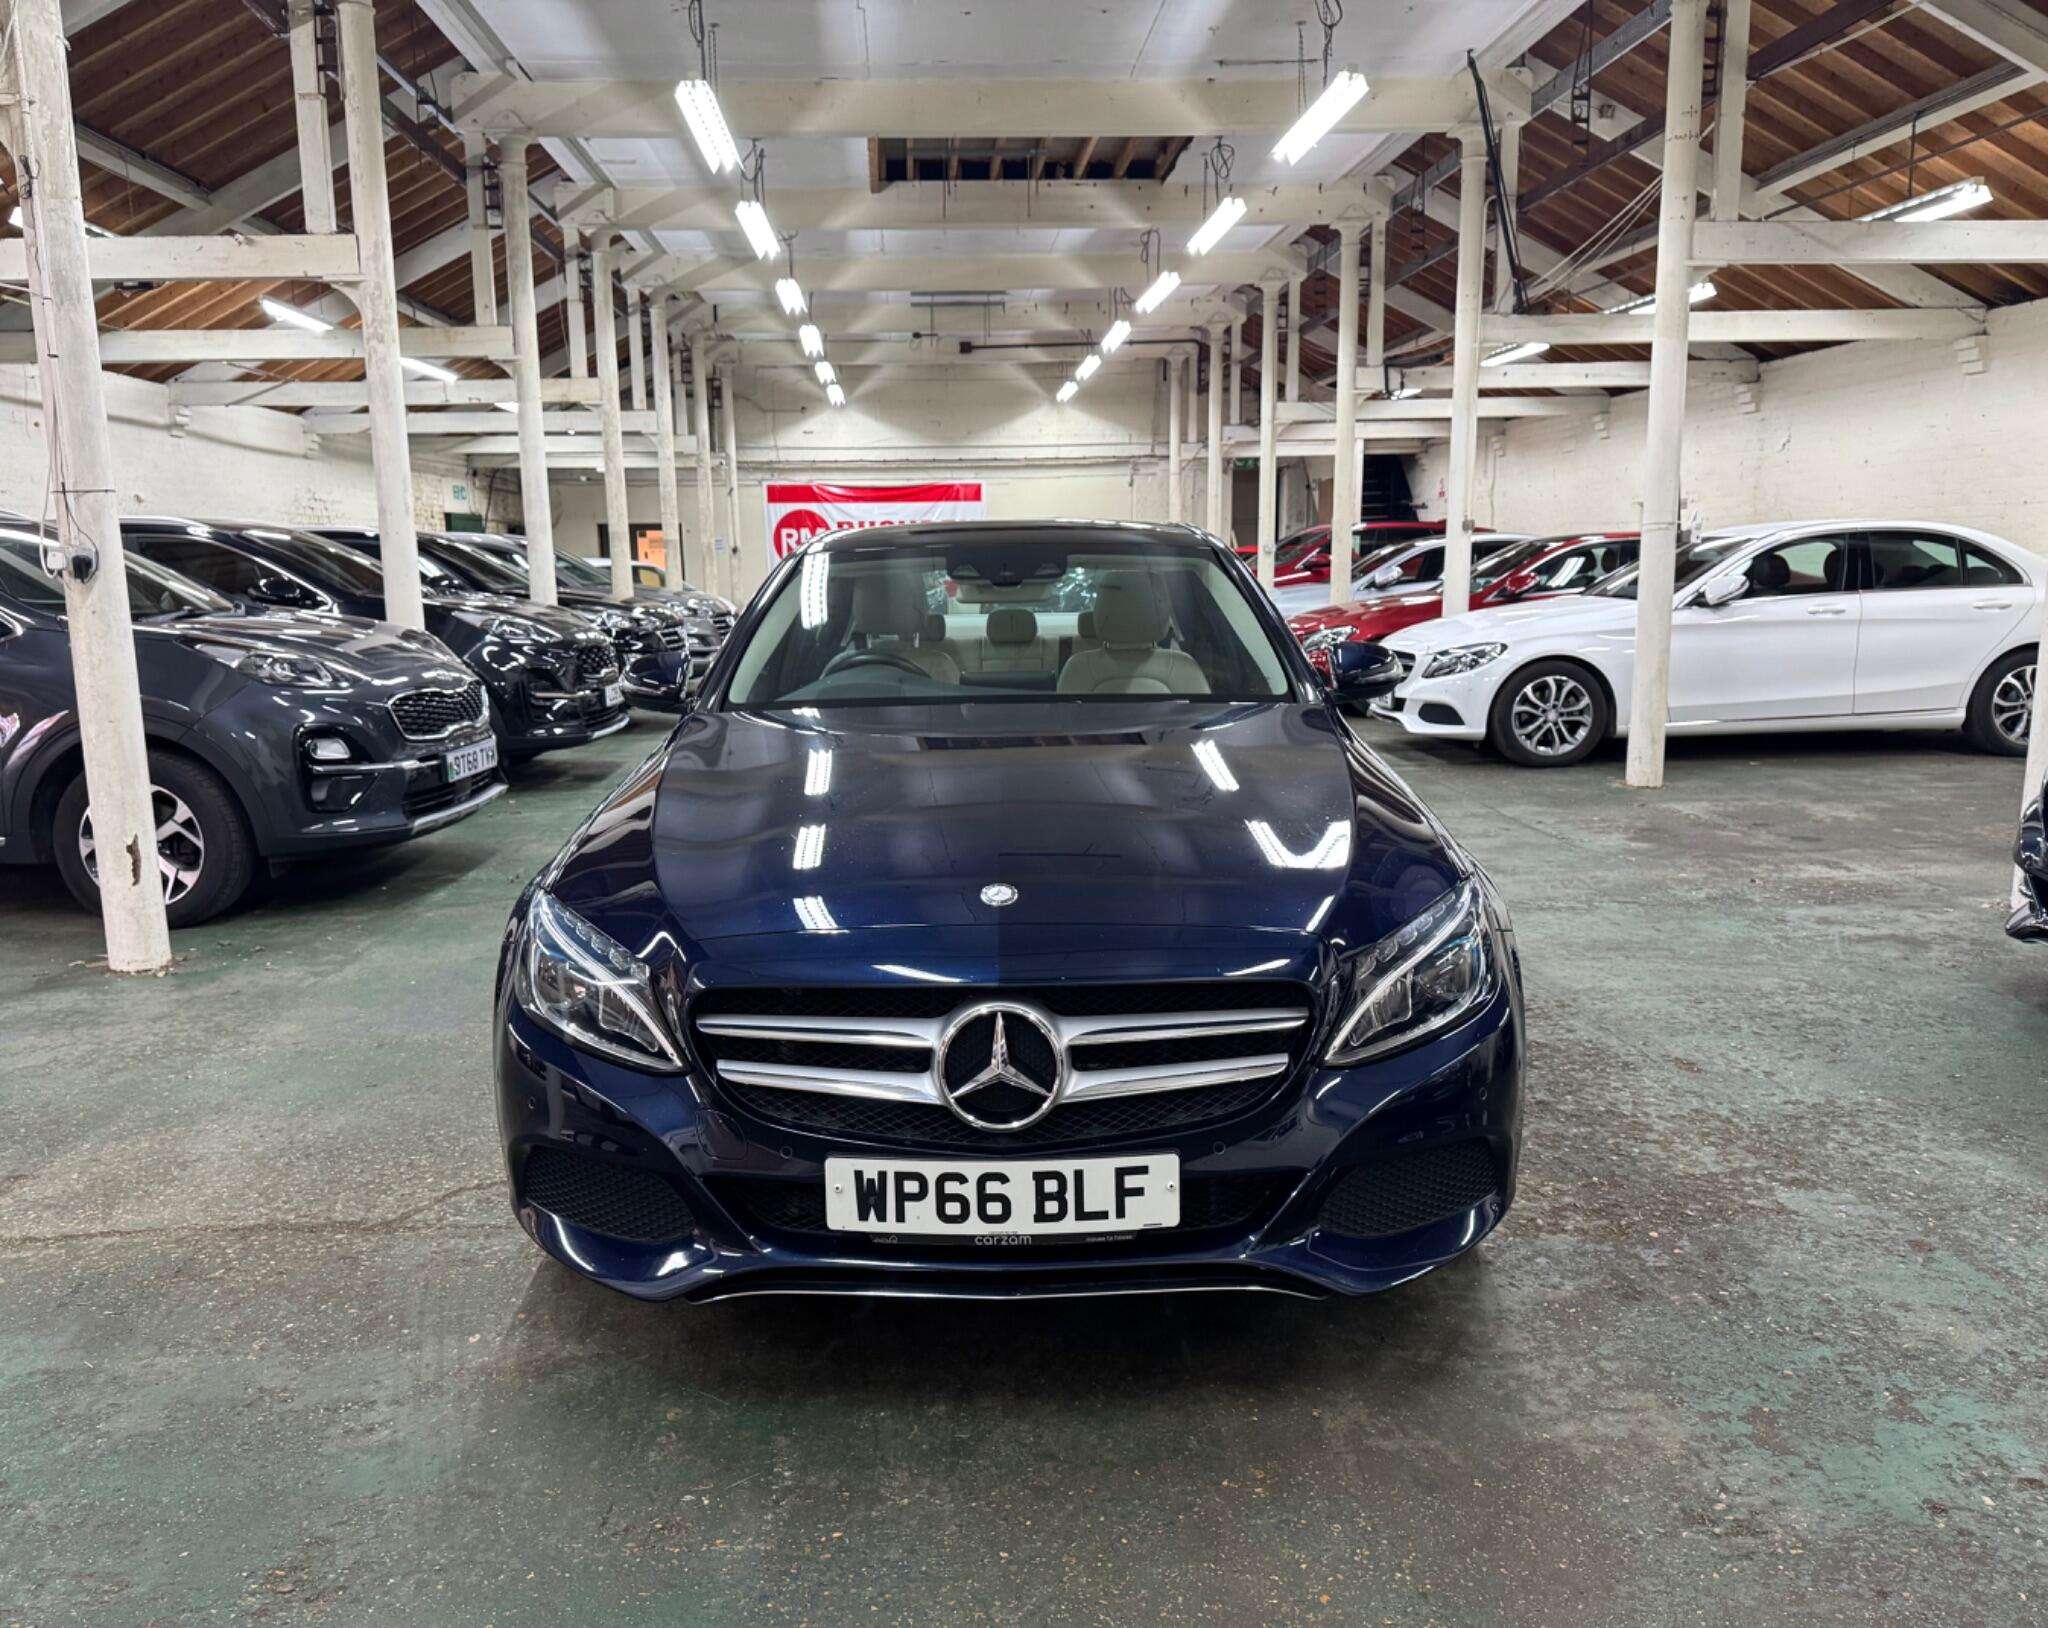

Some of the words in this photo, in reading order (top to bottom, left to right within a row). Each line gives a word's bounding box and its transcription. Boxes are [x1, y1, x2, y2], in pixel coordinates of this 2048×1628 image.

[854, 1169, 1012, 1225] WP66
[1032, 1165, 1149, 1224] BLF
[974, 1235, 1032, 1246] carzam
